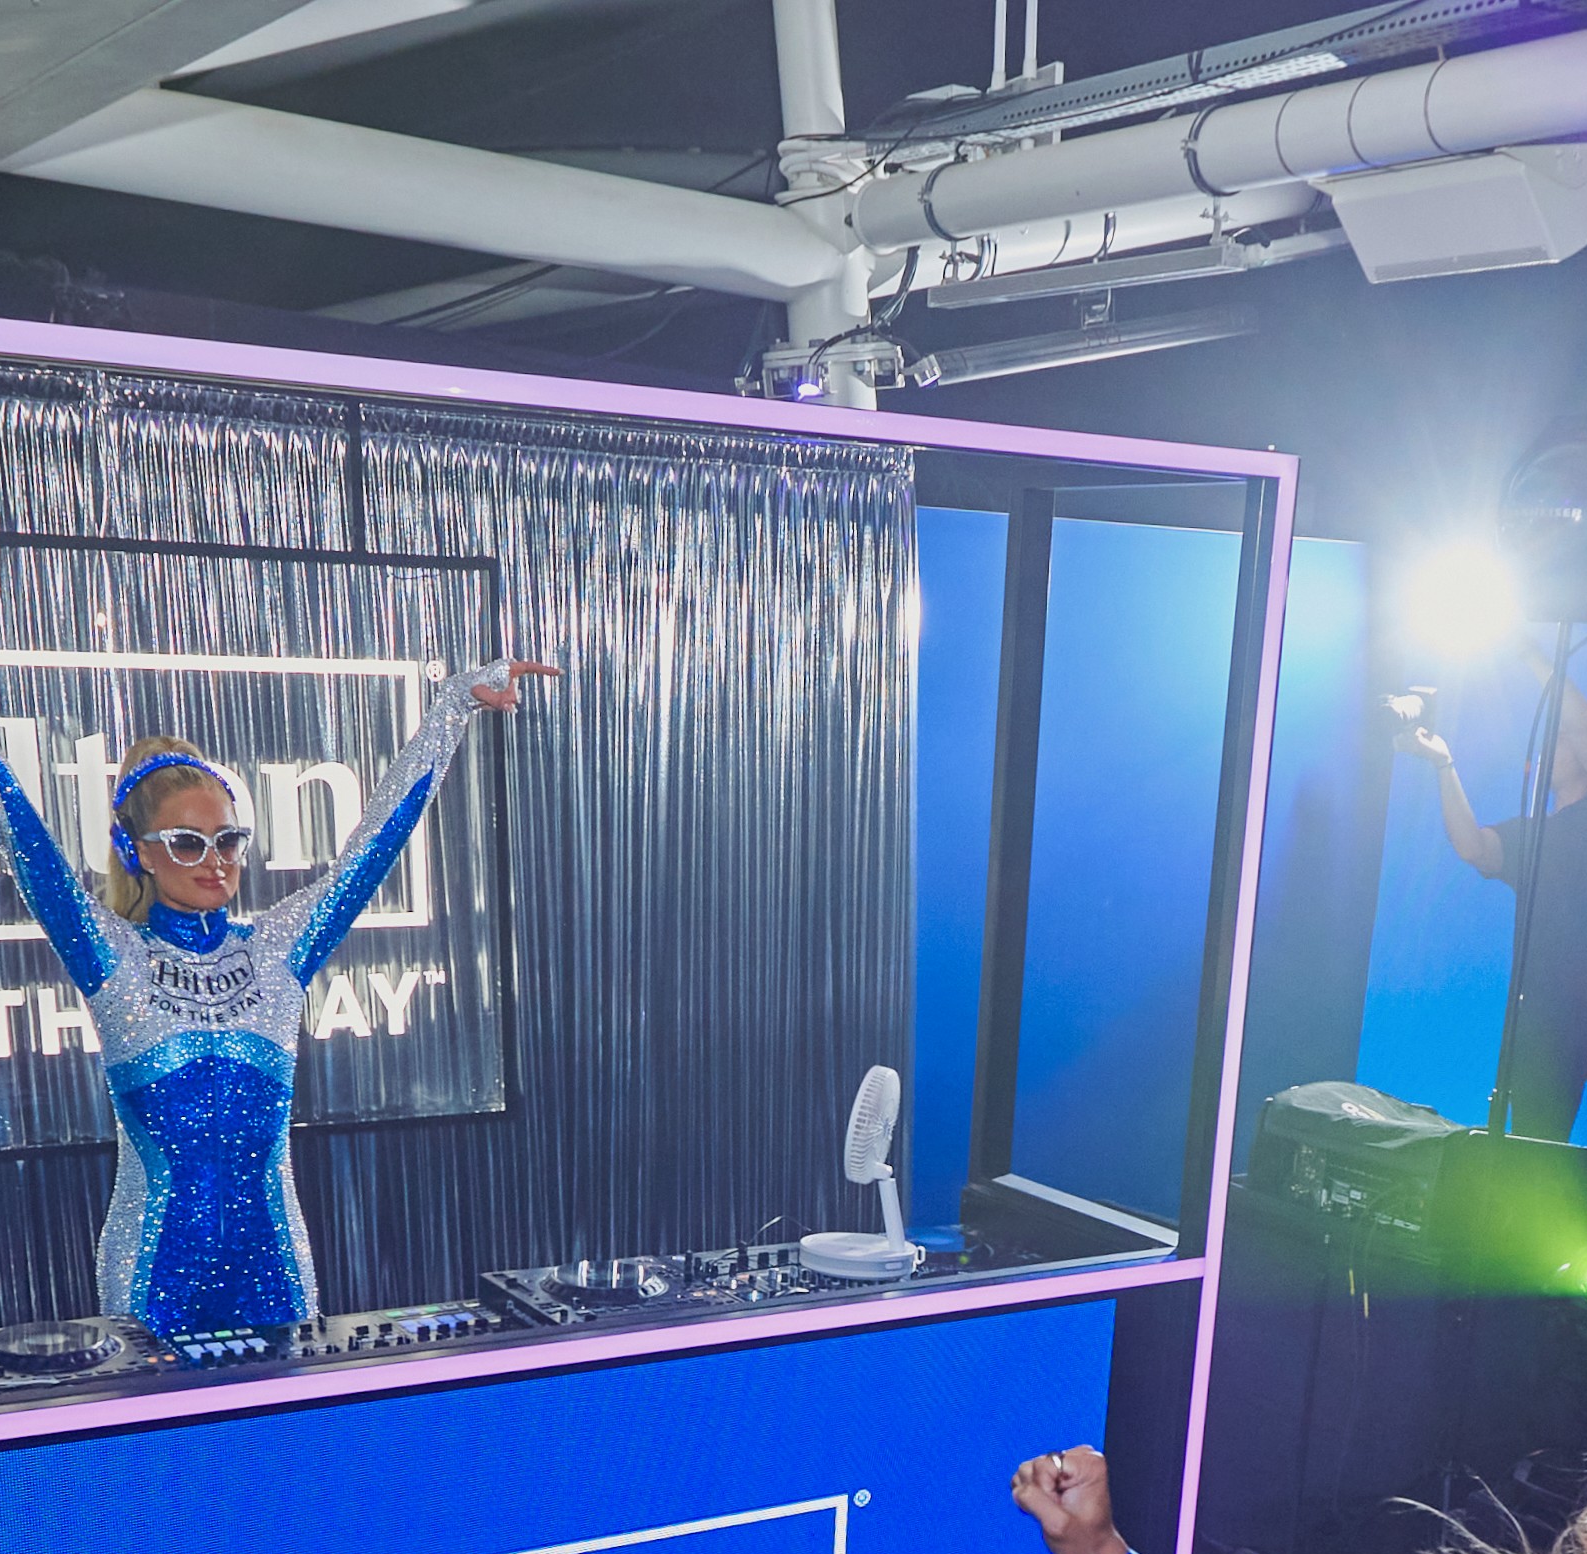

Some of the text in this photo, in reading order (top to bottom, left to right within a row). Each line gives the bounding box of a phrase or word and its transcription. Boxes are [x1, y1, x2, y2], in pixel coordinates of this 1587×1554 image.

[157, 960, 249, 995] Hilton
[149, 988, 265, 1024] FOR THE STAY
